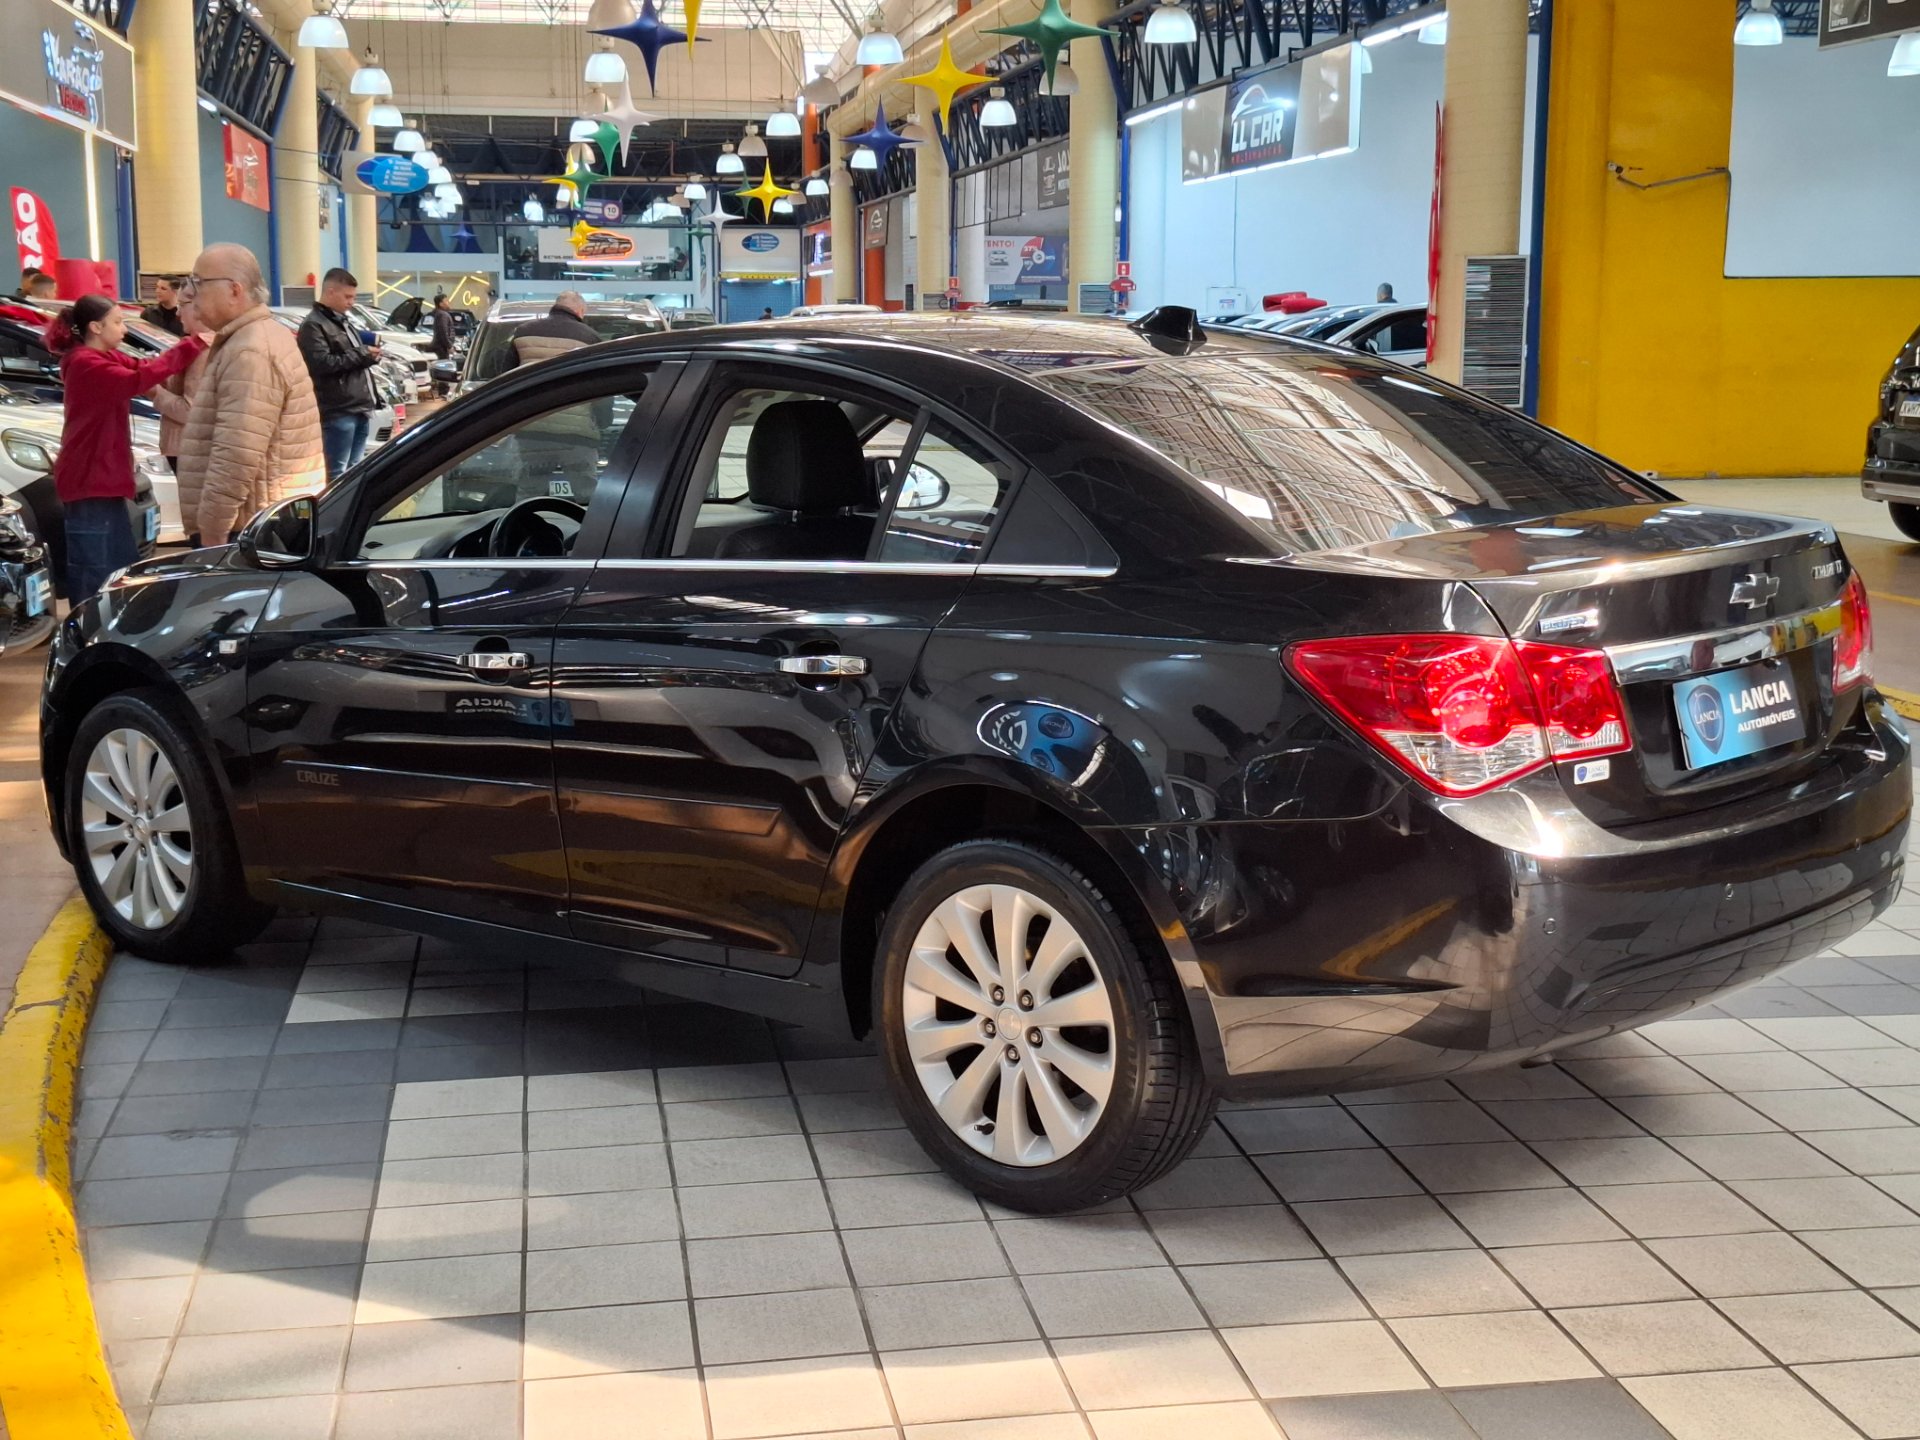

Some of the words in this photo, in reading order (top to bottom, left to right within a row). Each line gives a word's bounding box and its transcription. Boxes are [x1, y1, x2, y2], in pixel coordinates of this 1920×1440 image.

[1231, 120, 1247, 153] LL
[1250, 109, 1284, 148] CAR
[1729, 680, 1791, 715] LANCIA
[1694, 709, 1722, 724] LANCIA
[1737, 709, 1796, 733] AUTOMÓVEIS
[296, 770, 340, 786] CRUZE
